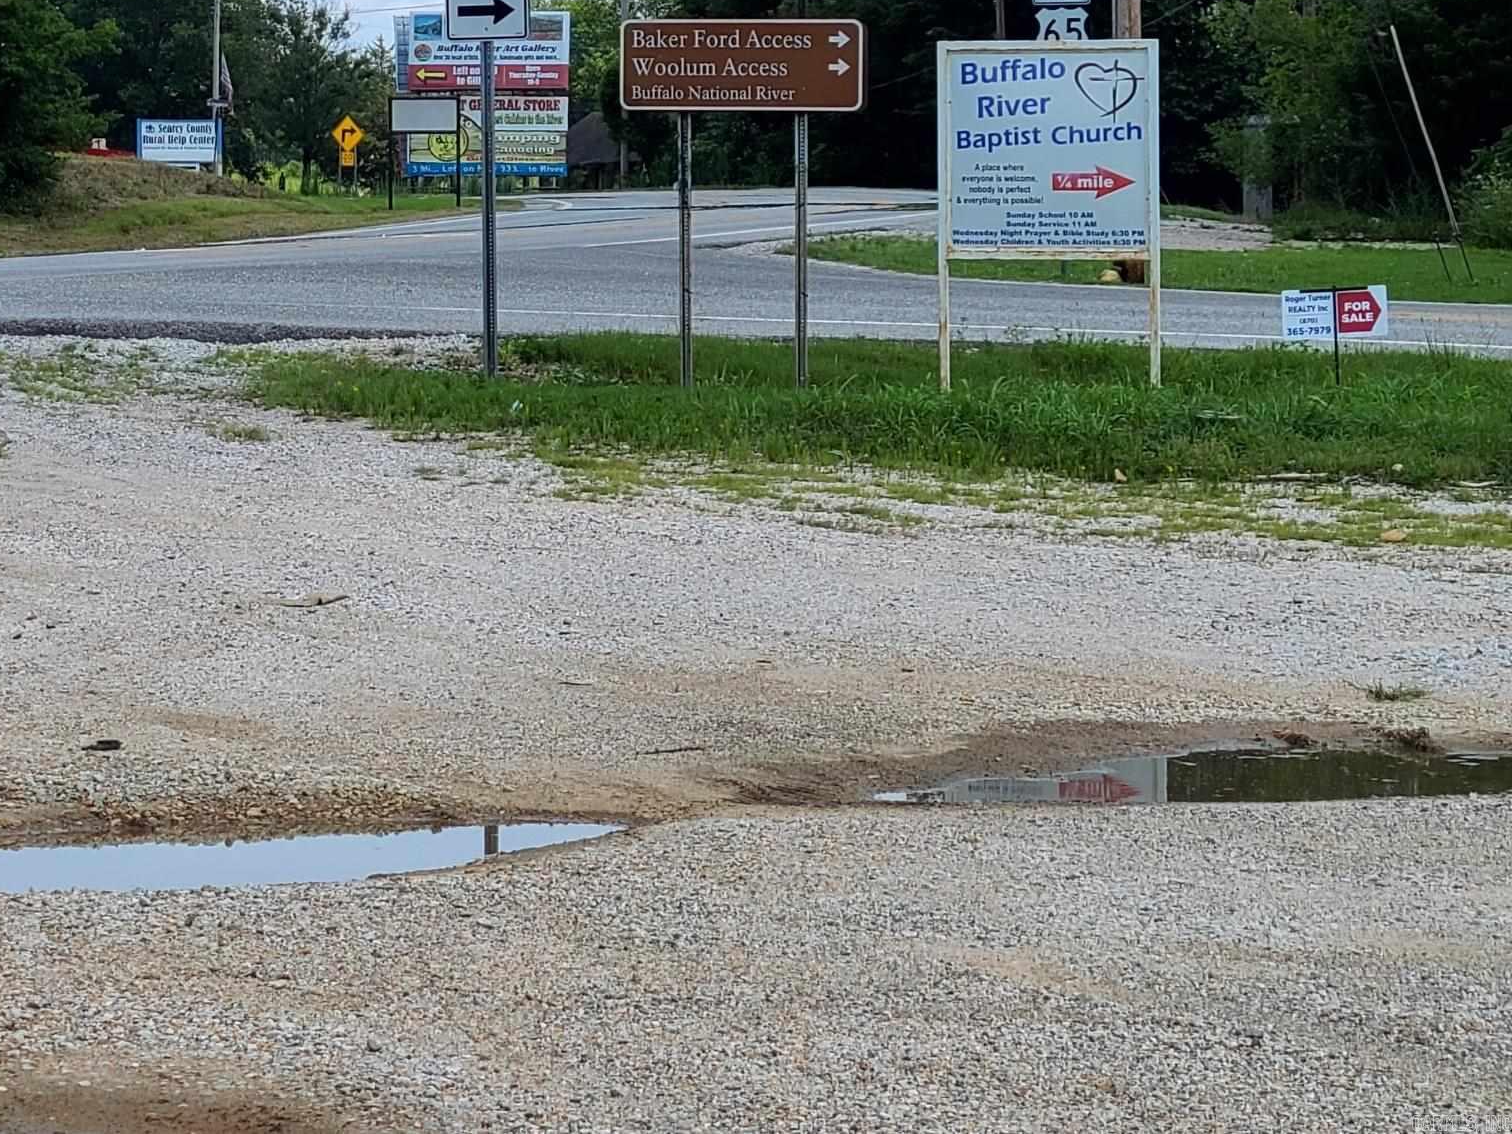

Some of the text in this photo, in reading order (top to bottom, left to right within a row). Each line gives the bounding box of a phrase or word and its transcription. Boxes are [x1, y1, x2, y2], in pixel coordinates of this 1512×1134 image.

[1043, 17, 1083, 40] 65
[631, 29, 812, 49] Baker Ford Access
[436, 44, 473, 53] Buffalo
[503, 44, 519, 52] Art
[521, 44, 558, 54] Gallery
[632, 57, 788, 77] Woolum Access
[960, 58, 1066, 85] Buffalo
[631, 85, 796, 101] Buffalo National River
[469, 99, 521, 111] GERAL
[523, 99, 561, 111] STORE
[977, 96, 1051, 119] River
[186, 123, 213, 134] County
[143, 135, 165, 145] Rural
[189, 134, 216, 145] Center
[479, 134, 561, 144] amping
[956, 122, 1143, 153] Baptist Church
[974, 163, 1024, 173] A place where
[961, 176, 995, 184] everyone
[1077, 176, 1114, 188] mile
[968, 186, 996, 195] nobody
[1005, 186, 1031, 195] perfect
[963, 196, 1001, 206] everything
[1010, 196, 1043, 205] possible!
[1005, 212, 1035, 220] Sunday
[952, 230, 998, 238] Wednesday
[1086, 230, 1109, 238] Study
[1343, 301, 1370, 312] FOR
[1341, 312, 1374, 323] SALE
[1287, 326, 1331, 336] 365-7979
